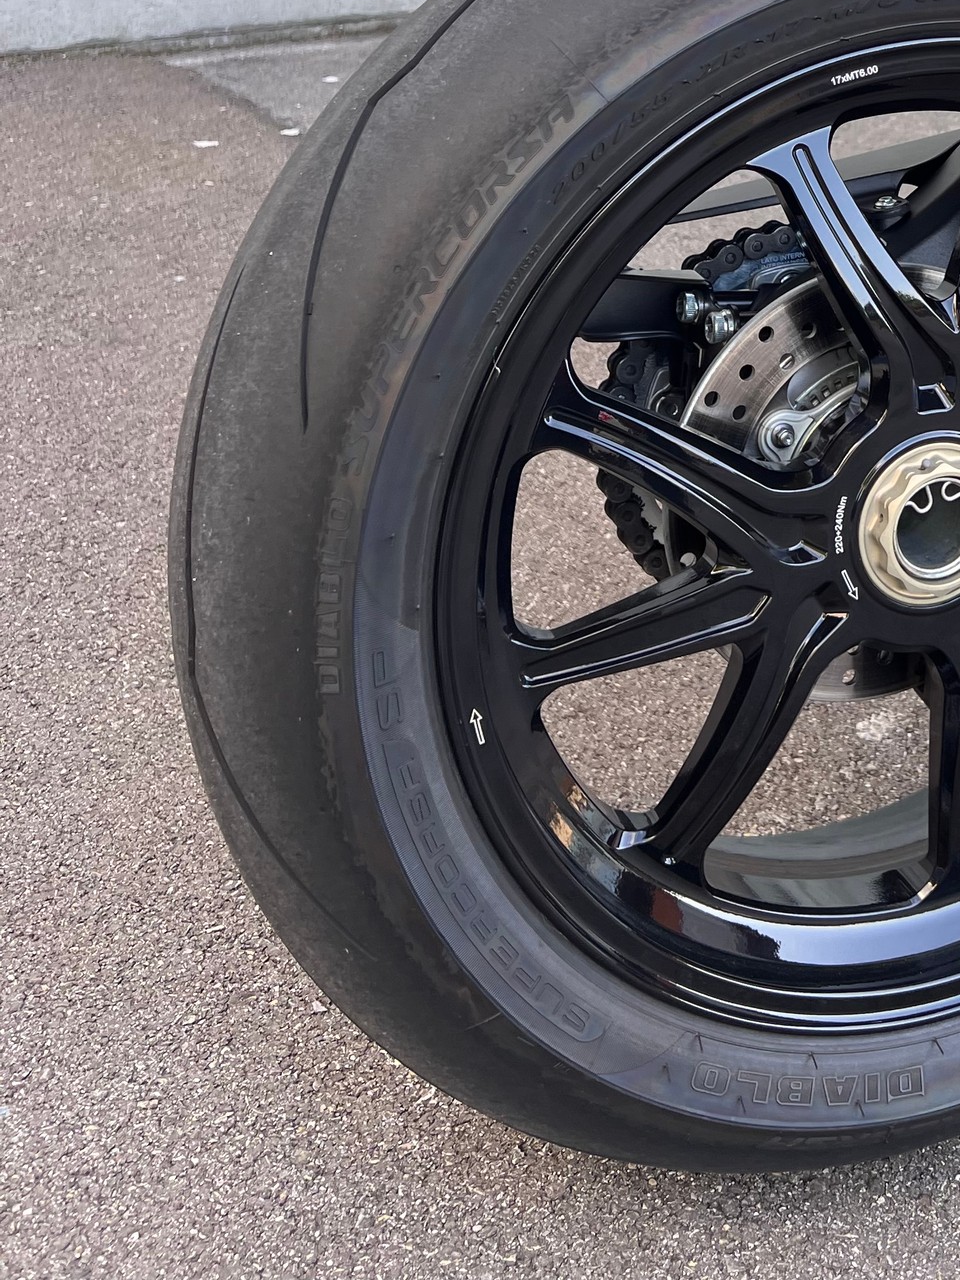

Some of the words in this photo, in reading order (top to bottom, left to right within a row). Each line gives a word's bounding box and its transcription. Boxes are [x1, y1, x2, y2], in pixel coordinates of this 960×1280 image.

[830, 65, 879, 86] 17xMT6.00
[343, 93, 576, 477] SUPERCORSA
[781, 251, 806, 261] INTERN
[314, 497, 352, 695] DIABLO
[372, 650, 401, 732] SP
[398, 755, 590, 1033] SUPERCORSA
[691, 1062, 925, 1107] DIABLO
